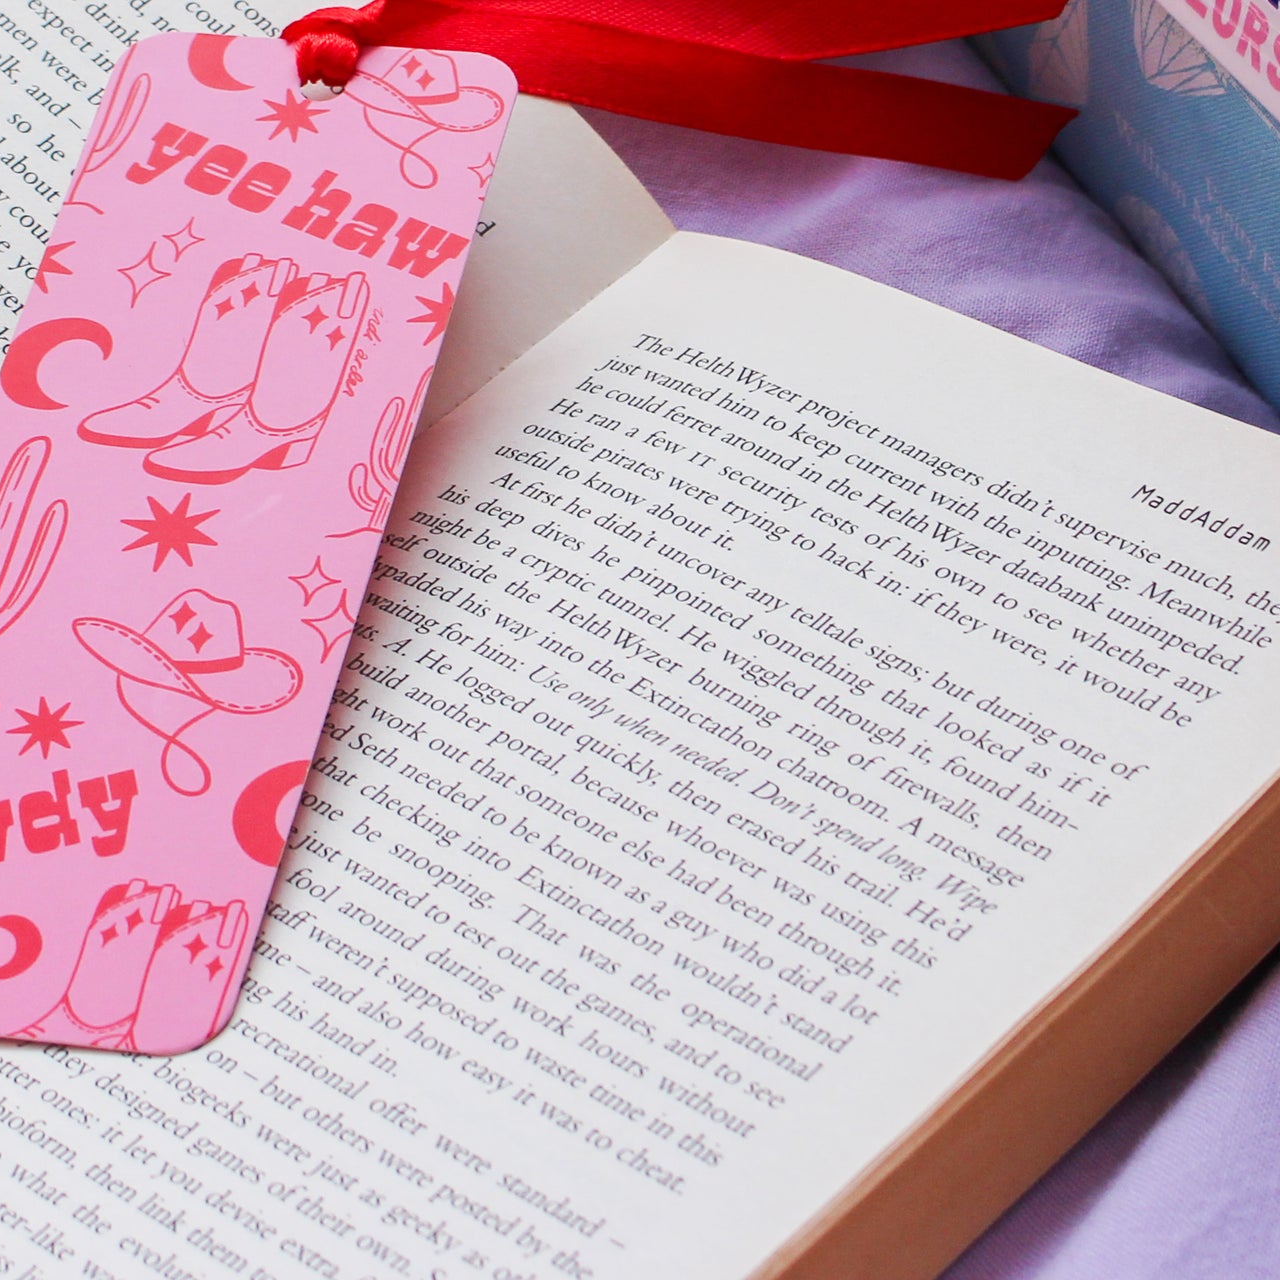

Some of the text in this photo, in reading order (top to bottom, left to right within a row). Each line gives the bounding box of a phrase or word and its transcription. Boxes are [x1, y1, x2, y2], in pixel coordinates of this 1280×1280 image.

[125, 122, 468, 280] yee haw
[493, 444, 735, 552] useful to know about it.
[592, 354, 1273, 648] just wanted him to keep current with the inputting. Meanwhile
[632, 332, 674, 357] The
[794, 398, 881, 439] project
[878, 433, 984, 487] managers
[985, 479, 1055, 518] didn’t
[1053, 512, 1162, 564] supervise
[1162, 558, 1234, 600] much,
[1130, 483, 1271, 552] MaddAddam
[488, 471, 1150, 781] At first he didn’t uncover any telltale signs; but during one of
